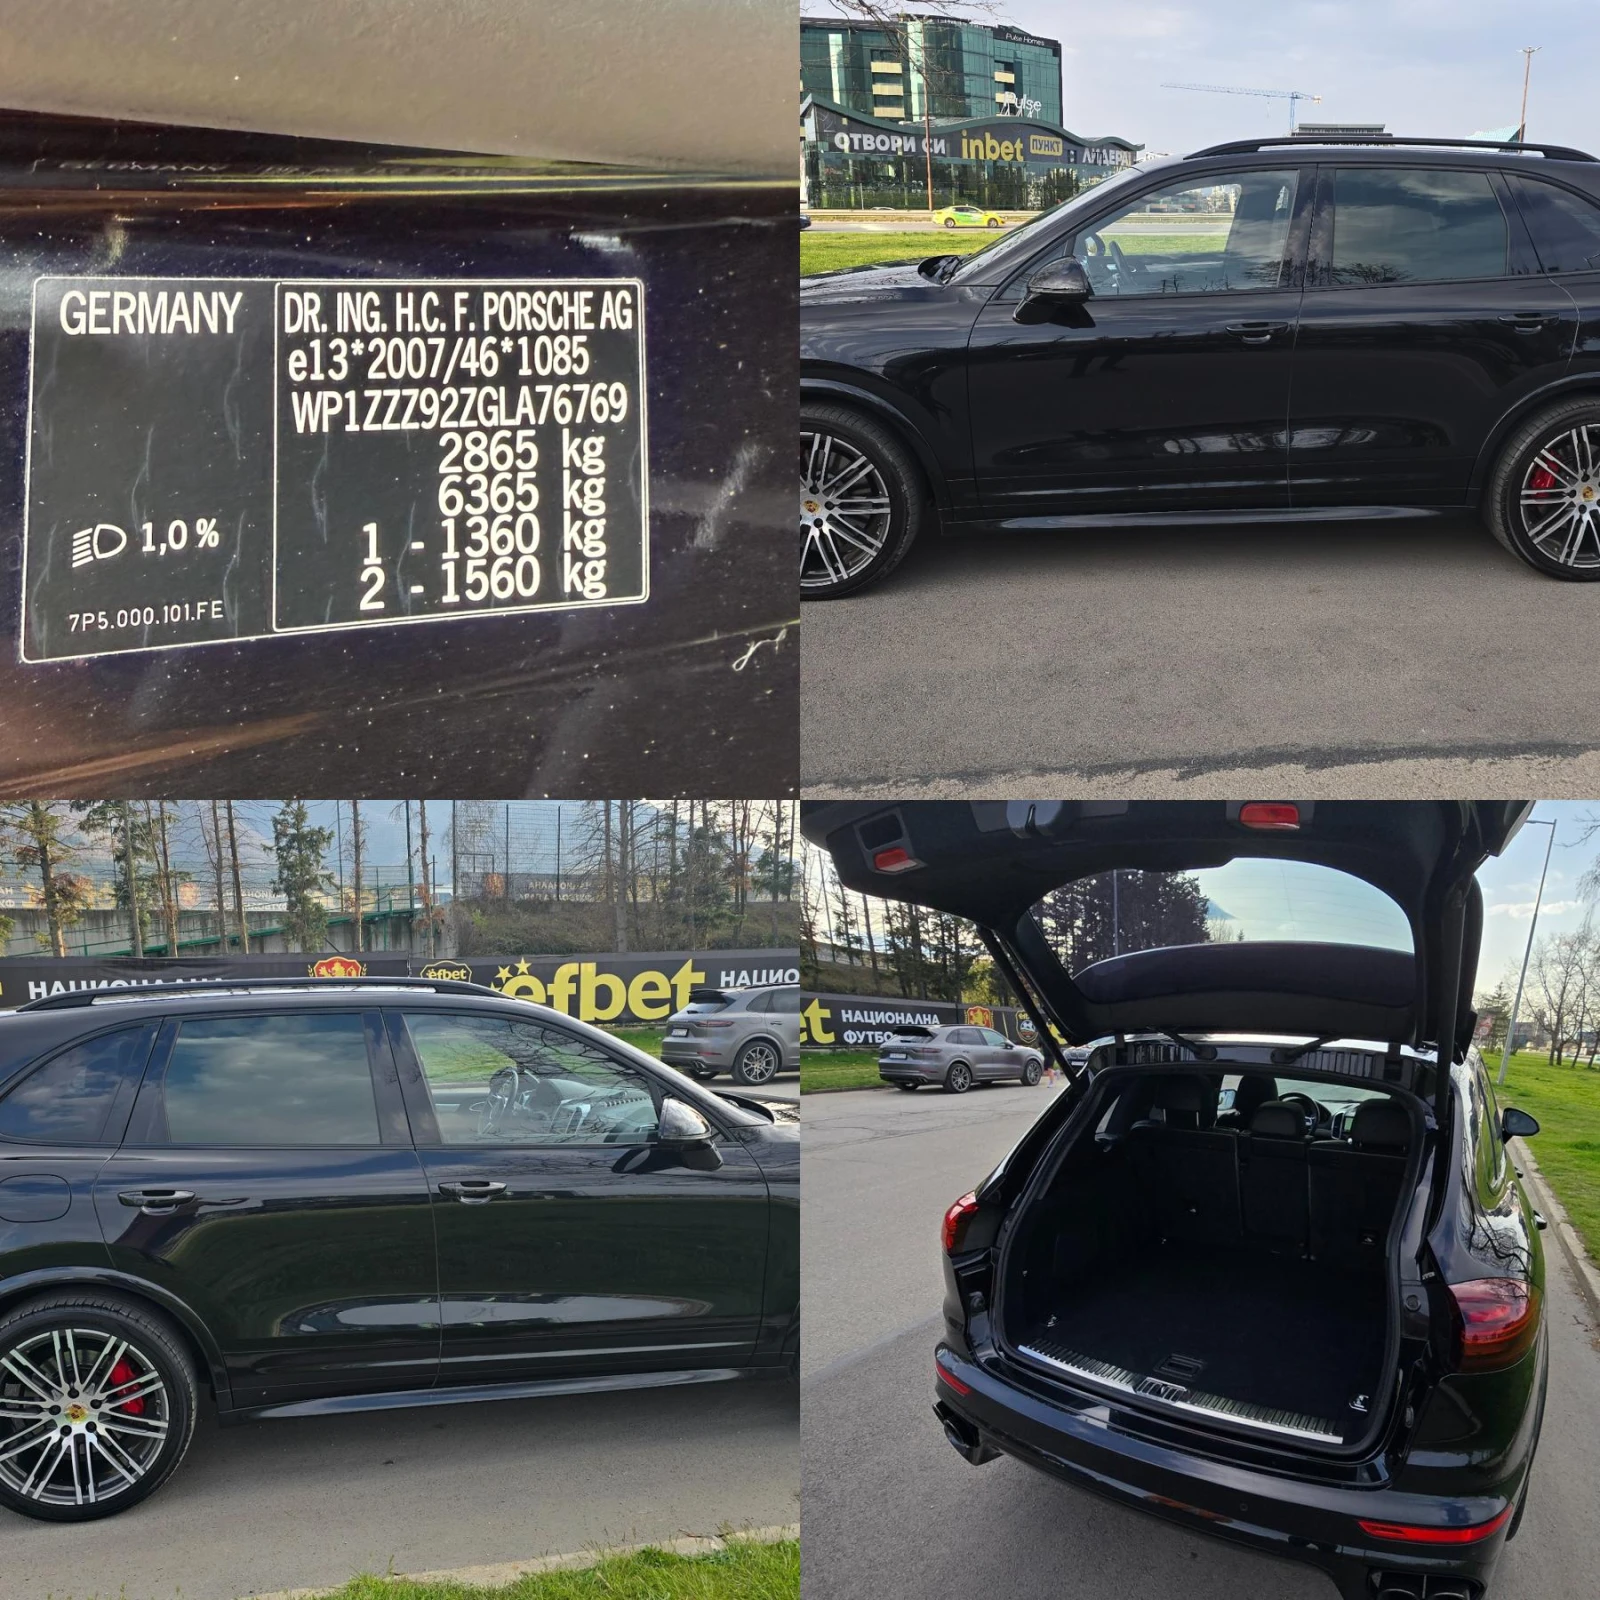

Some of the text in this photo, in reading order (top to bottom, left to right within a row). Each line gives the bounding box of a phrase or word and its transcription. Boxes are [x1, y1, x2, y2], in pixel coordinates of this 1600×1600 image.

[1004, 91, 1042, 111] Pulse
[834, 132, 946, 154] ОТВОРИ СИ
[961, 129, 1024, 162] inbet
[1031, 138, 1061, 153] ПУНКТ
[59, 289, 243, 335] GERMANY
[284, 290, 633, 334] DR. ING. H.C. F. PORSCHE AG
[291, 382, 629, 434] WP1ZZZ92ZGLA76769
[438, 428, 606, 475] 2865 kg
[438, 469, 606, 517] 6365 kg
[142, 517, 220, 556] 1,0 %
[362, 522, 382, 566] 1
[441, 512, 540, 560] 1360
[563, 511, 607, 558] kg
[359, 566, 386, 611] 2
[441, 555, 541, 603] 1560
[563, 552, 607, 600] kg
[69, 600, 224, 632] 7P5.000.101.FE
[428, 968, 467, 980] efbet
[502, 958, 706, 1021] efbet
[720, 968, 800, 987] НАЦИО
[841, 1009, 940, 1026] НАЦИОНАЛНА
